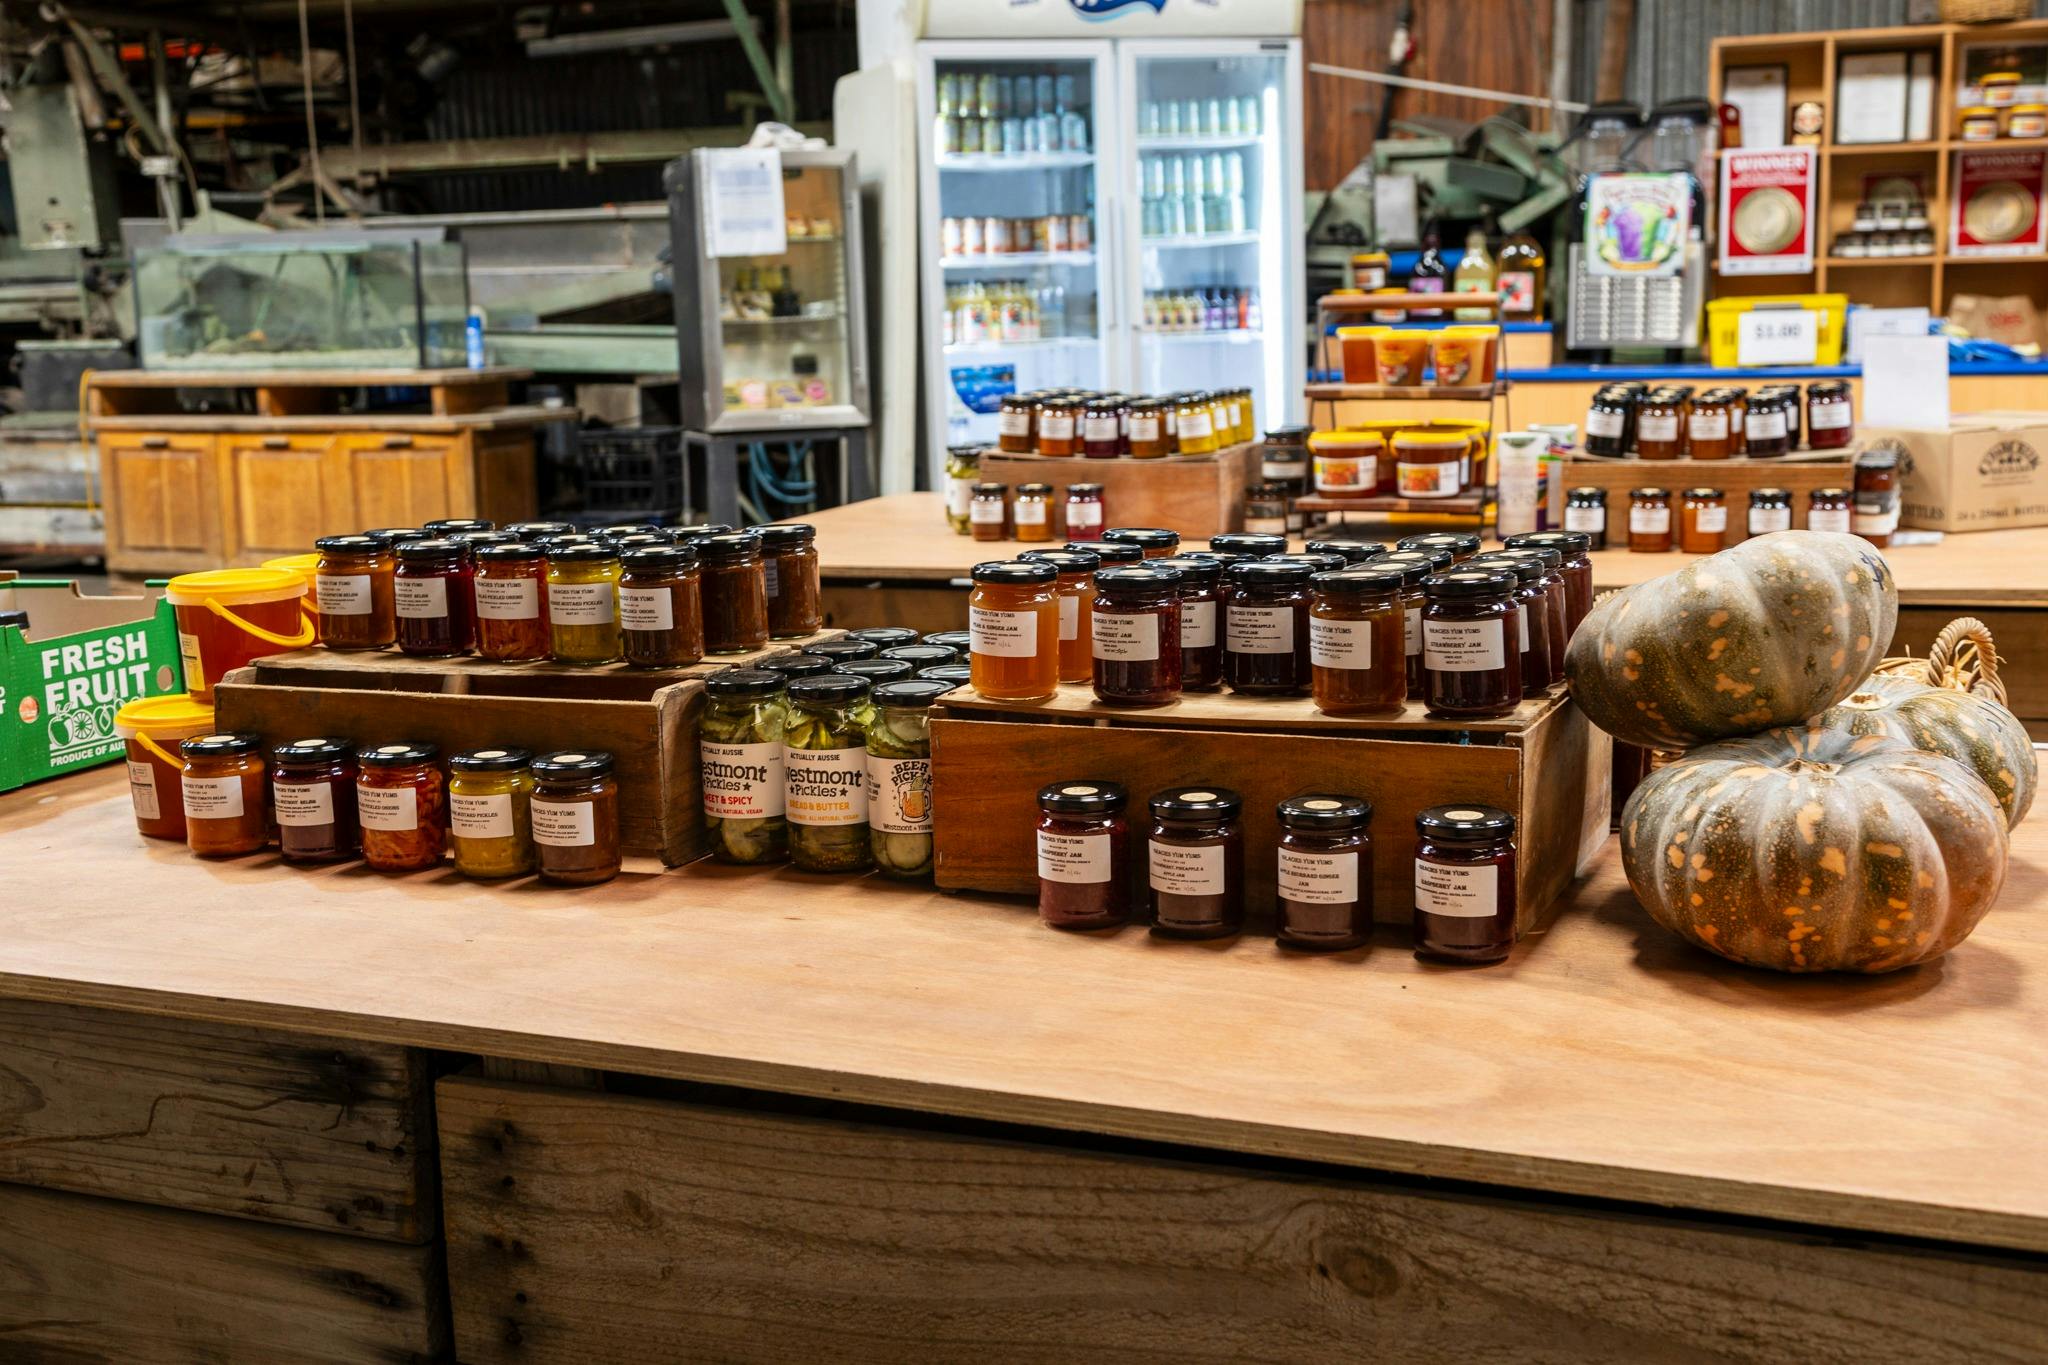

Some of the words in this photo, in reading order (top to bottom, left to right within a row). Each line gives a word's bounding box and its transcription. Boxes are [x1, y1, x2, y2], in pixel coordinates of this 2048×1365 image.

[1733, 155, 1806, 172] WINNER
[1322, 626, 1333, 634] YUM
[1430, 641, 1466, 649] STRAWBERRY
[41, 630, 148, 679] FRESH
[45, 662, 150, 715] FRUIT
[702, 746, 721, 755] CTUALLY
[722, 748, 744, 756] AUSSIE
[790, 751, 816, 761] ACTUALLY
[51, 751, 94, 767] PRODUCE
[95, 746, 107, 755] OF
[702, 760, 768, 783] estmont
[893, 760, 929, 775] BEER
[795, 784, 837, 798] Pickles
[728, 796, 753, 805] SPICY
[816, 801, 850, 811] BUTTER
[1172, 851, 1184, 859] YUM
[1303, 857, 1316, 865] YUM
[1439, 868, 1451, 876] YUM
[1452, 869, 1470, 877] YUMS
[1421, 879, 1452, 891] RASPBERRY
